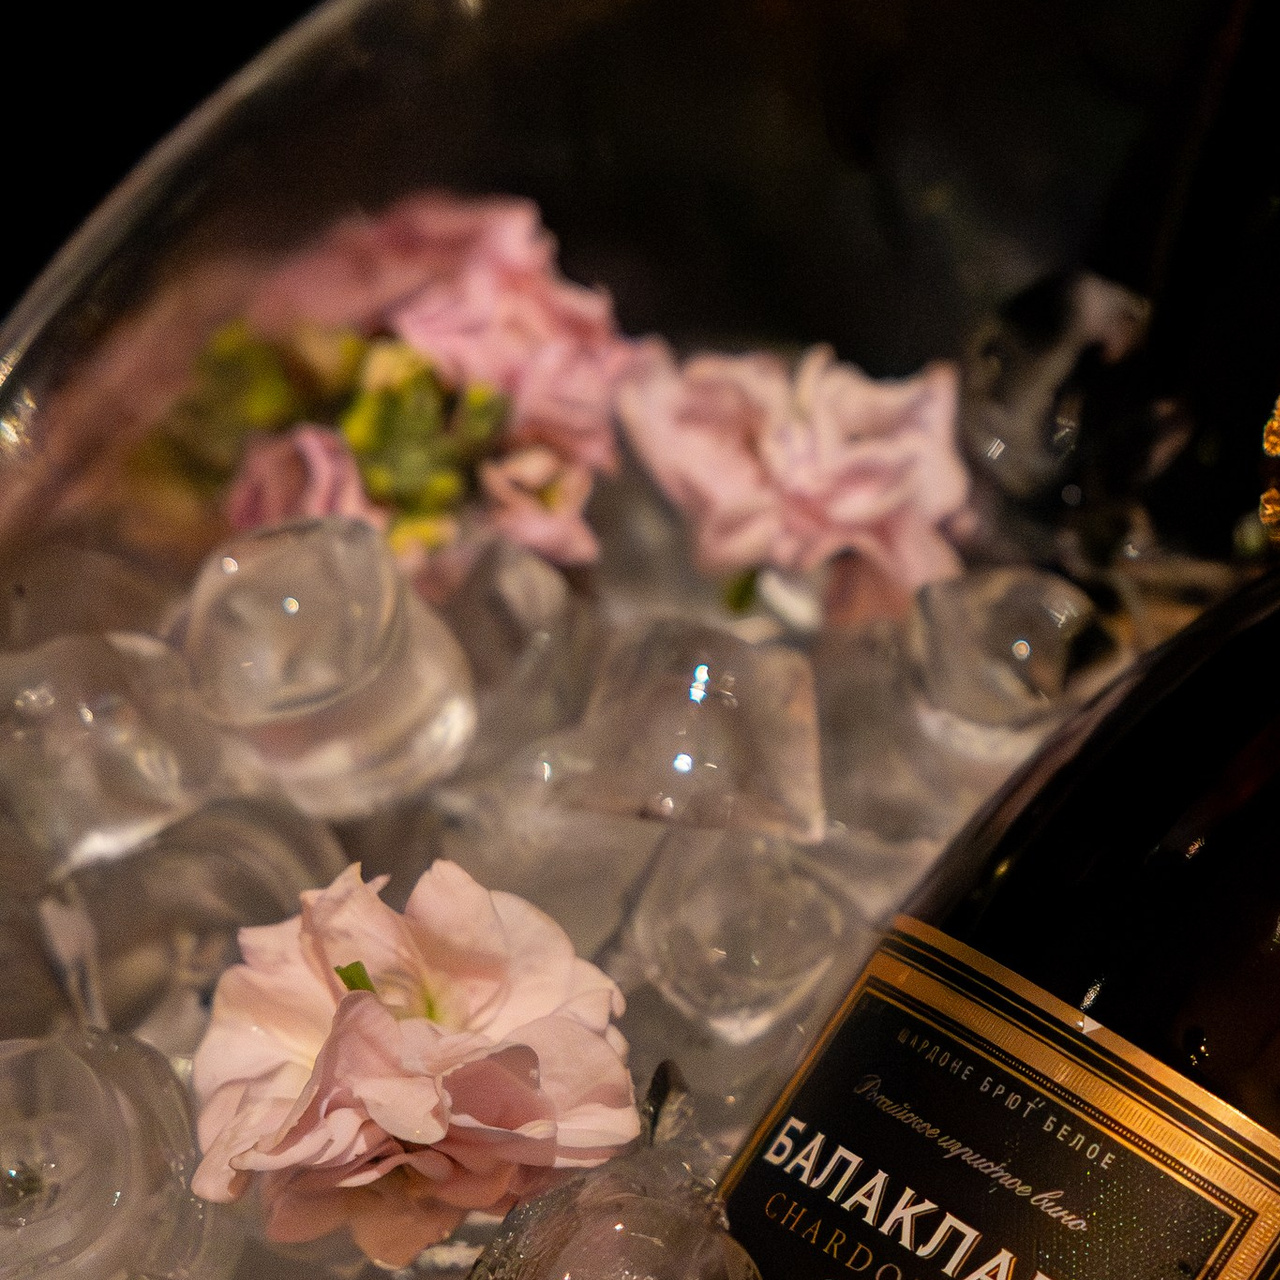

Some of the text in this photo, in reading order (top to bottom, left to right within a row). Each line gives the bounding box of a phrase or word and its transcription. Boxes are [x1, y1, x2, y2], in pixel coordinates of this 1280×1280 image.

[896, 1027, 1116, 1169] ШАРДОНЕ БРЮТ БЕЛОЕ
[1029, 1190, 1088, 1232] вино
